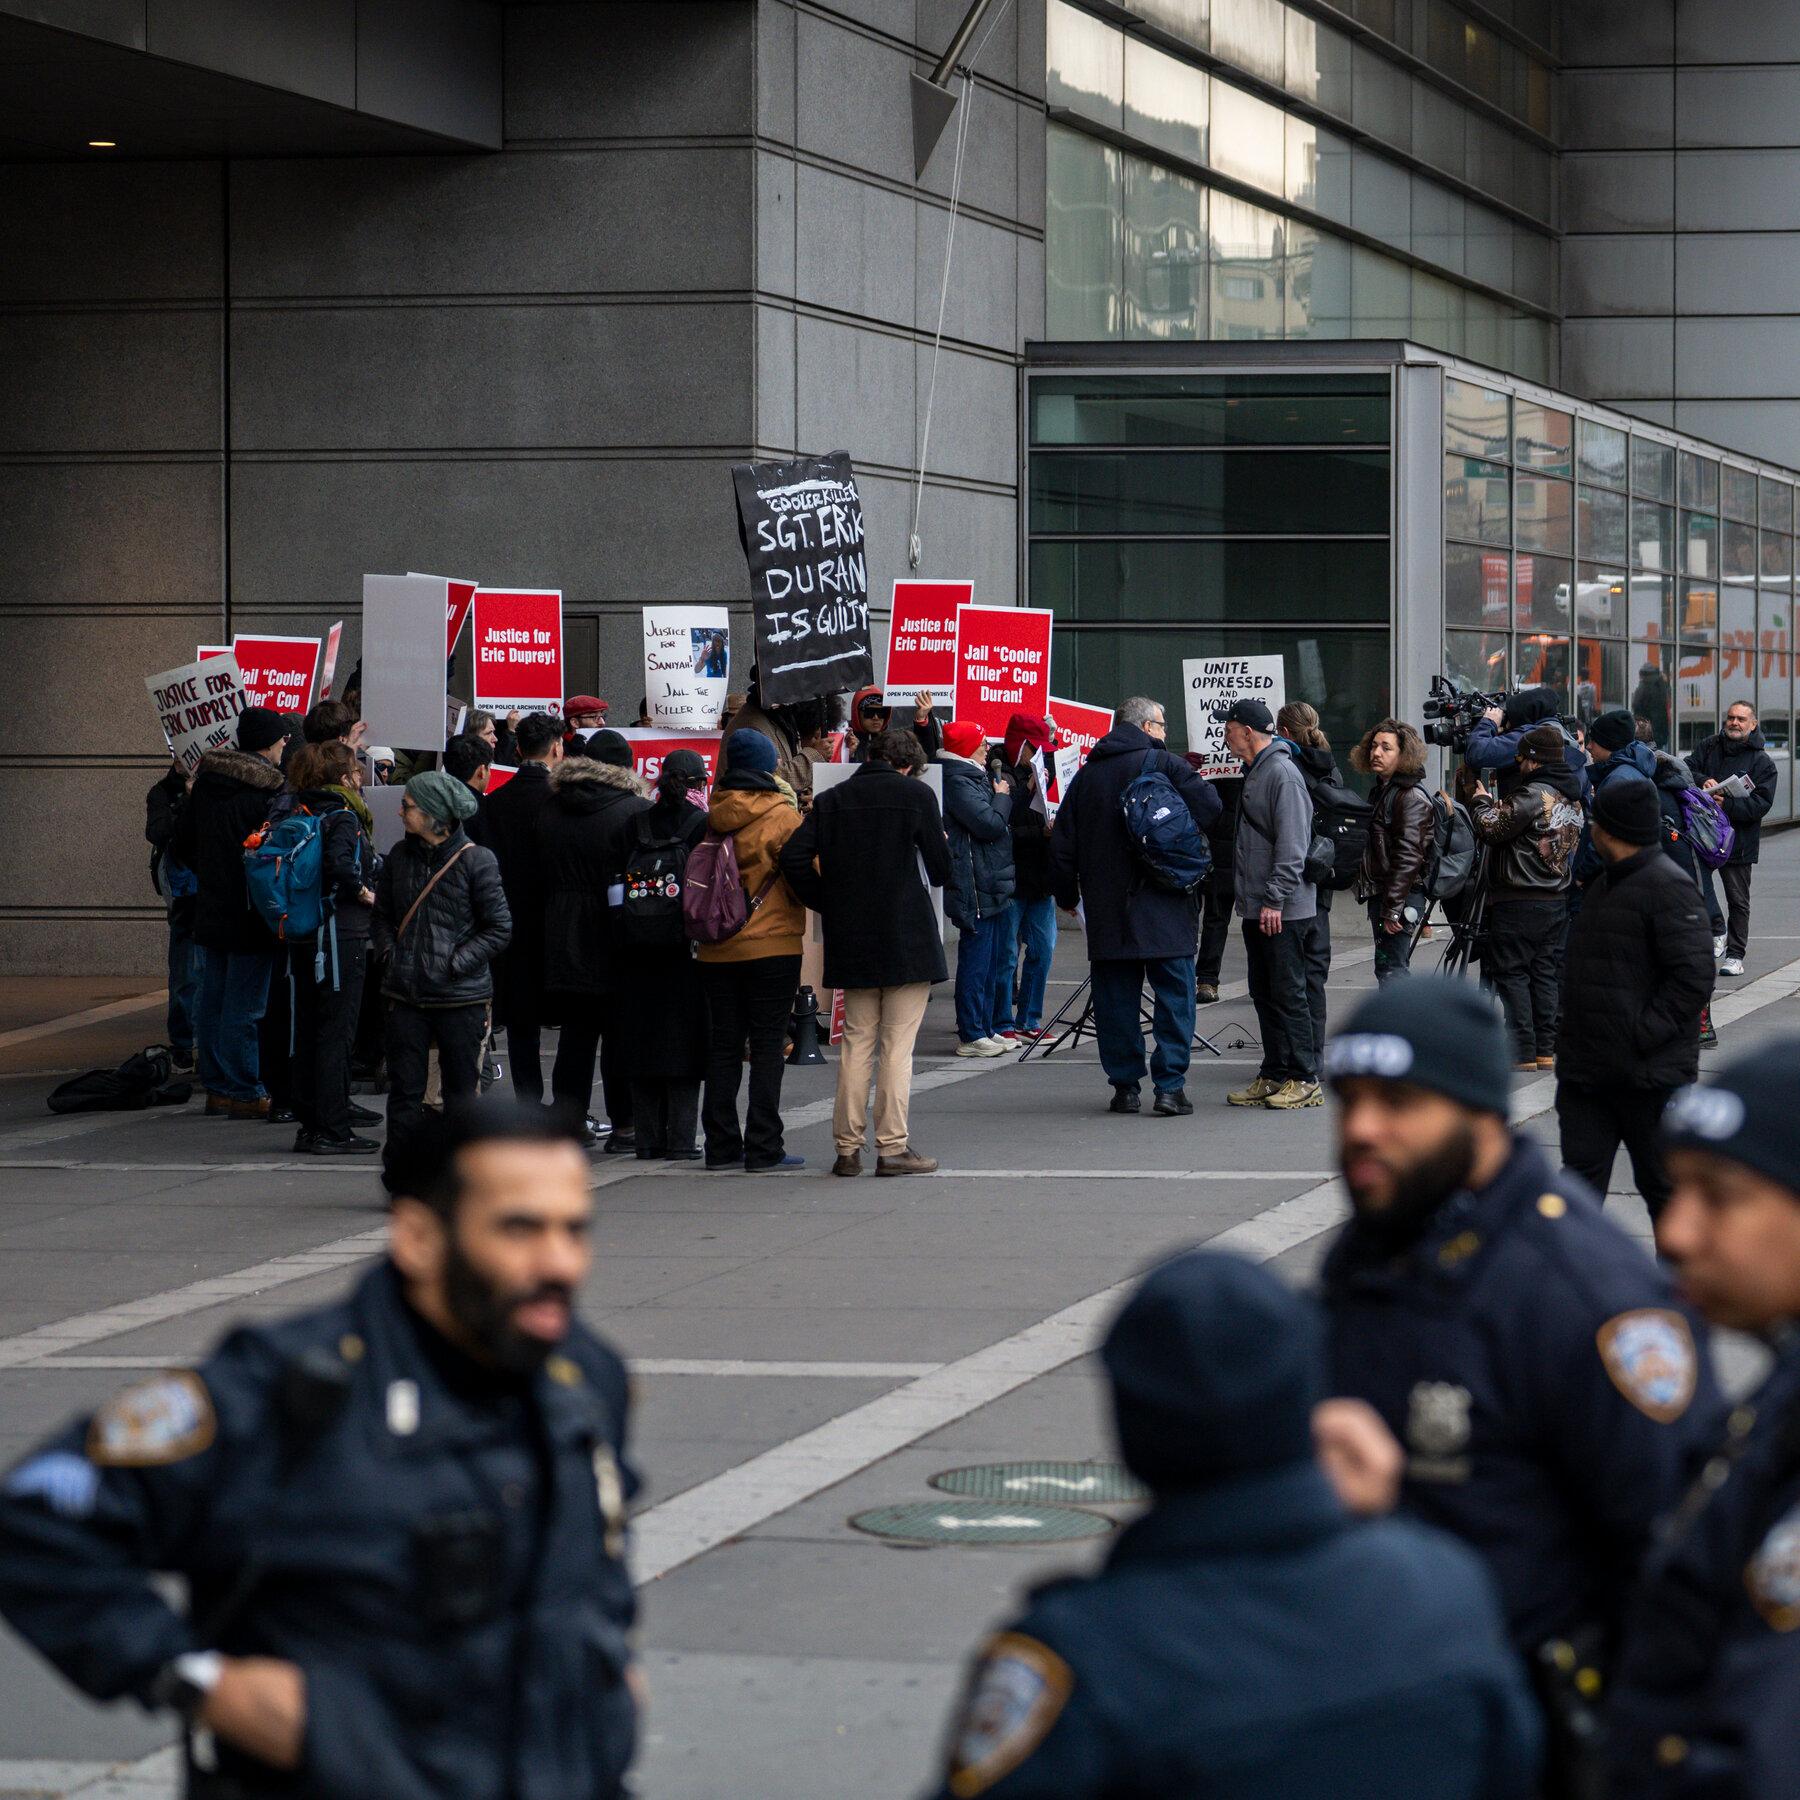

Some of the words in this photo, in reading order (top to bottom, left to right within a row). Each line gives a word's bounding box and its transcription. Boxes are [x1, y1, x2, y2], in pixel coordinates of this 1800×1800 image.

[765, 552, 867, 600] DURAN
[646, 620, 687, 637] JUSTICE
[766, 608, 812, 645] IS
[900, 618, 941, 633] Justice
[484, 628, 529, 644] Justice
[533, 628, 551, 644] for
[895, 636, 917, 651] Eric
[660, 641, 676, 649] FOR
[964, 644, 989, 662] Jail
[481, 646, 505, 663] Eric
[508, 648, 556, 665] Duprey!
[647, 653, 693, 671] SANIYAH!
[1013, 667, 1037, 686] Cop
[1204, 662, 1249, 674] UNITE
[662, 682, 689, 698] JAIL
[695, 687, 709, 697] THE
[1192, 676, 1273, 689] OPPRESSED
[154, 677, 200, 712] JUSTICE
[205, 672, 236, 696] FOR
[276, 691, 300, 709] Cop
[980, 686, 1023, 704] Duran!
[1219, 690, 1238, 698] AND
[655, 703, 693, 715] KILLER
[205, 725, 231, 747] THE
